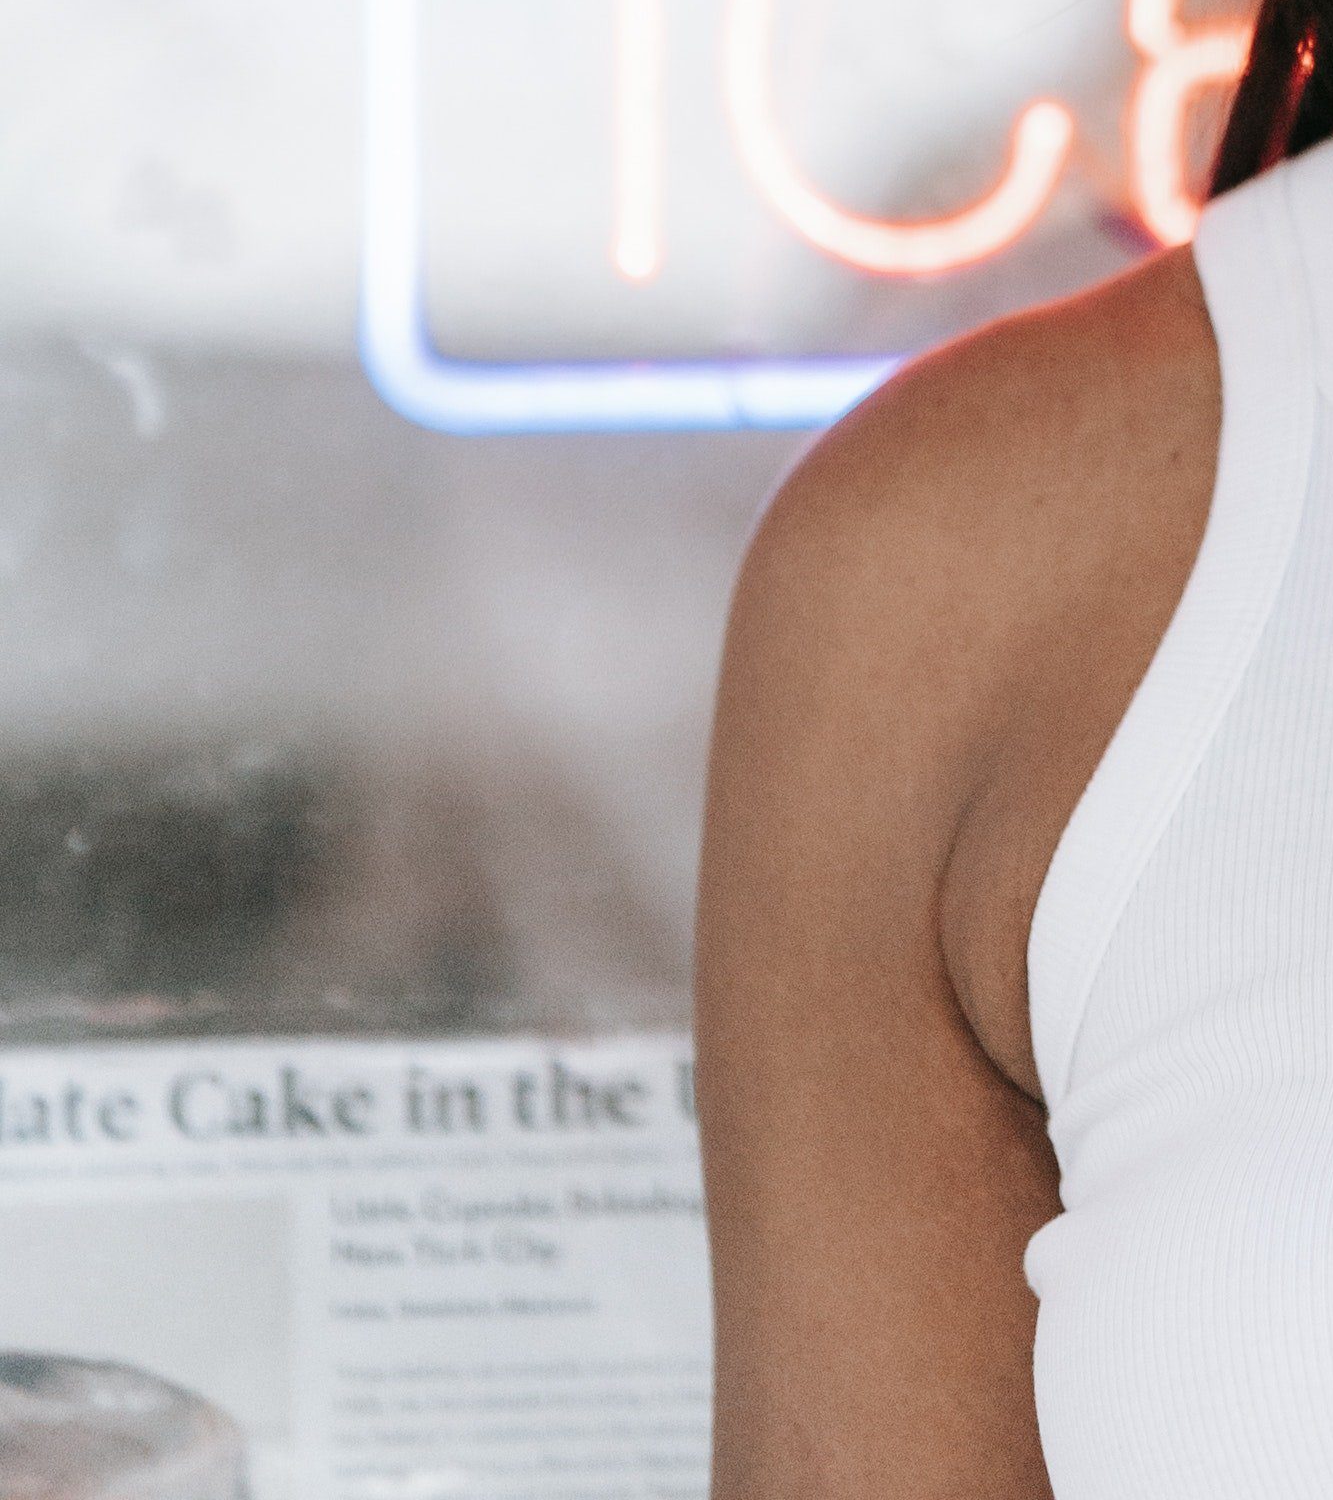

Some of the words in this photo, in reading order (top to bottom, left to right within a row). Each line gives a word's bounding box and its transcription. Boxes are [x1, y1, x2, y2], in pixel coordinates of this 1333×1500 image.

[166, 1066, 374, 1141] Cake
[403, 1066, 488, 1135] in
[509, 1060, 648, 1134] the
